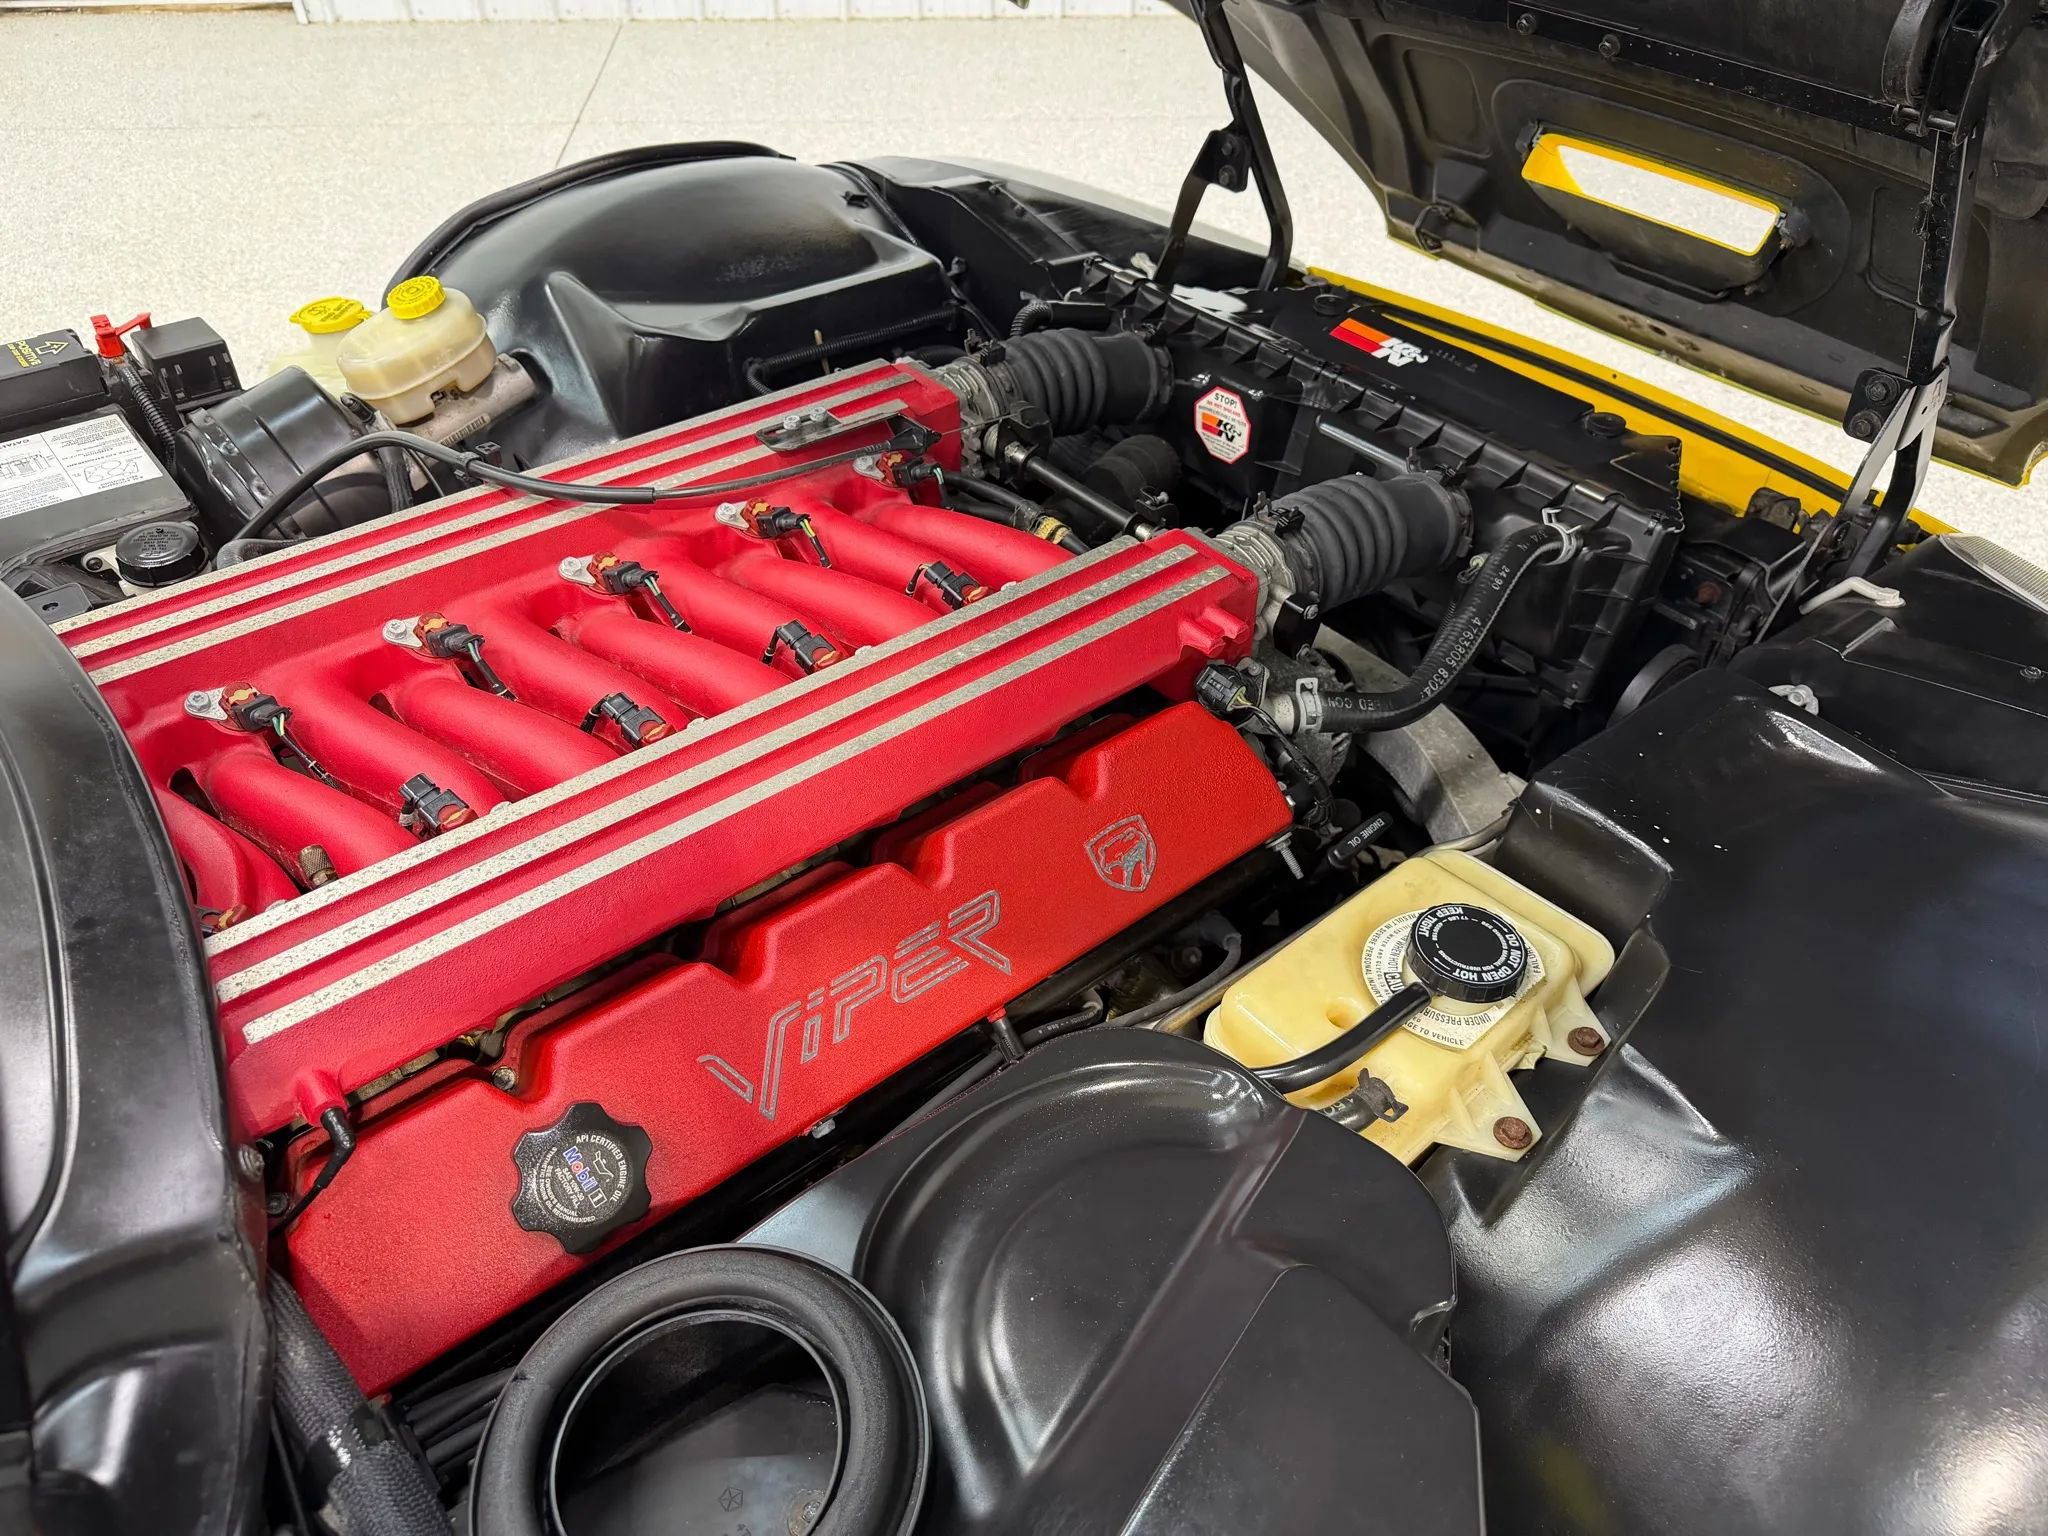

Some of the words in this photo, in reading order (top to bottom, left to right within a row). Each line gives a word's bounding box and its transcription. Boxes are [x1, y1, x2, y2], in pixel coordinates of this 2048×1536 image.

[1370, 337, 1429, 367] K&N
[1214, 392, 1238, 409] STOP!
[1360, 818, 1385, 840] ENGINE
[1347, 836, 1362, 848] OIL
[1435, 906, 1464, 918] KEEP
[1418, 914, 1438, 938] TIGHT
[1371, 928, 1386, 946] SEVERE
[1505, 933, 1520, 947] DO
[1390, 940, 1404, 957] WHEN
[1507, 948, 1522, 969] NOT
[1364, 946, 1375, 975] PERSONAL
[1452, 968, 1477, 981] HOT
[1481, 965, 1513, 982] OPEN
[1368, 976, 1384, 998] INJURY
[1463, 1013, 1492, 1026] UNDER
[1420, 1026, 1430, 1035] TO
[1432, 1032, 1465, 1046] VEHICLE
[576, 1134, 589, 1144] API
[590, 1134, 623, 1161] CERTIFIED
[562, 1145, 599, 1193] Mobil
[617, 1159, 628, 1191] ENGINE
[540, 1146, 558, 1178] SYNTHETIC
[552, 1207, 596, 1223] RECOMMENDED
[554, 1168, 573, 1195] FACTORY
[562, 1167, 573, 1182] SAE
[570, 1179, 585, 1202] 10W-30
[609, 1190, 622, 1202] OIL
[556, 1202, 579, 1217] MANUAL
